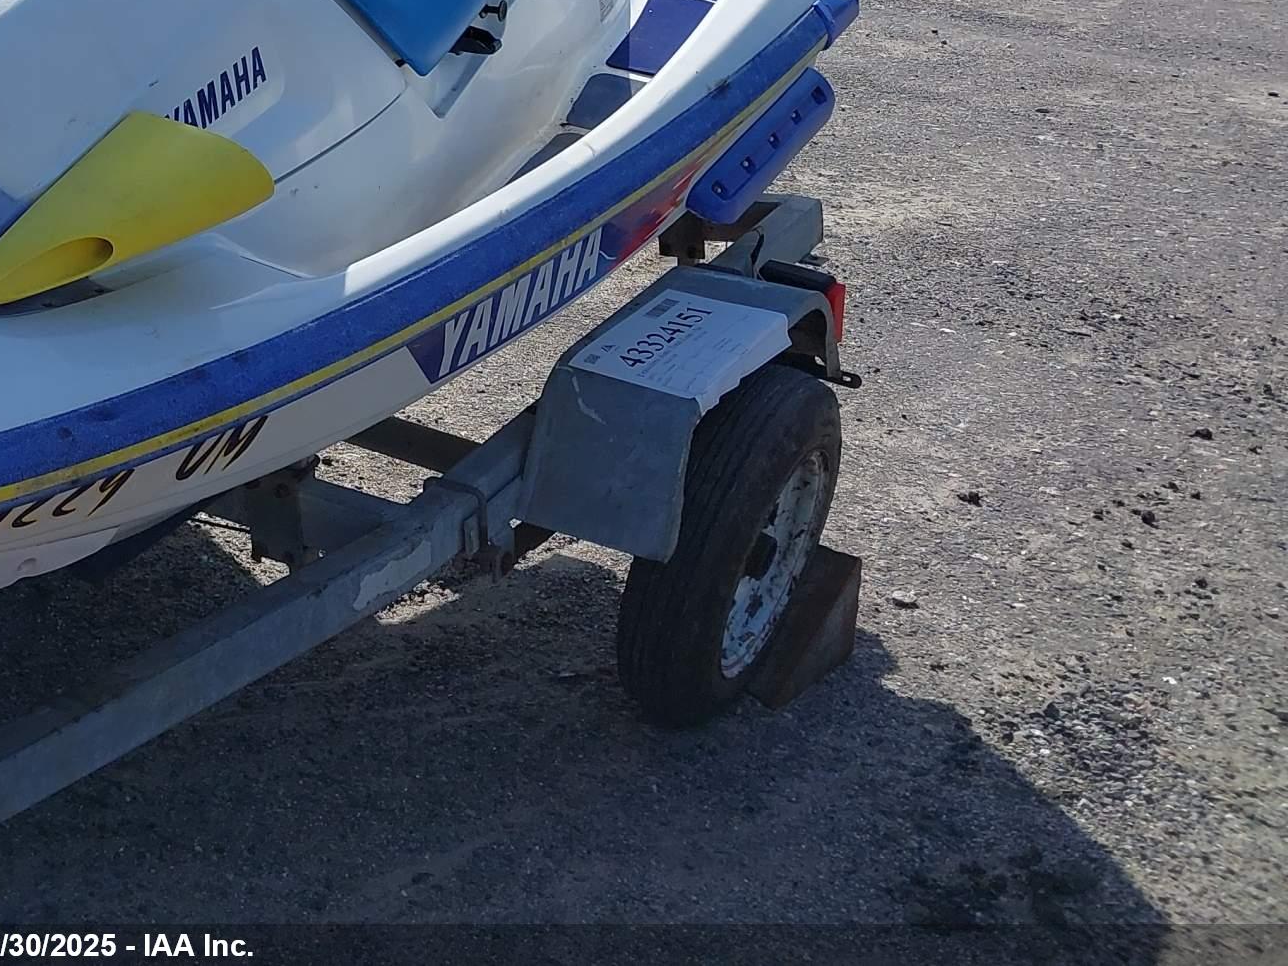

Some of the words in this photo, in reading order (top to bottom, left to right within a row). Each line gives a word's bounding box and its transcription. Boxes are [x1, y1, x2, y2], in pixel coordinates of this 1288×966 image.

[164, 46, 267, 129] AMAHA
[438, 226, 603, 379] YAMAHA
[619, 307, 713, 368] 43324151
